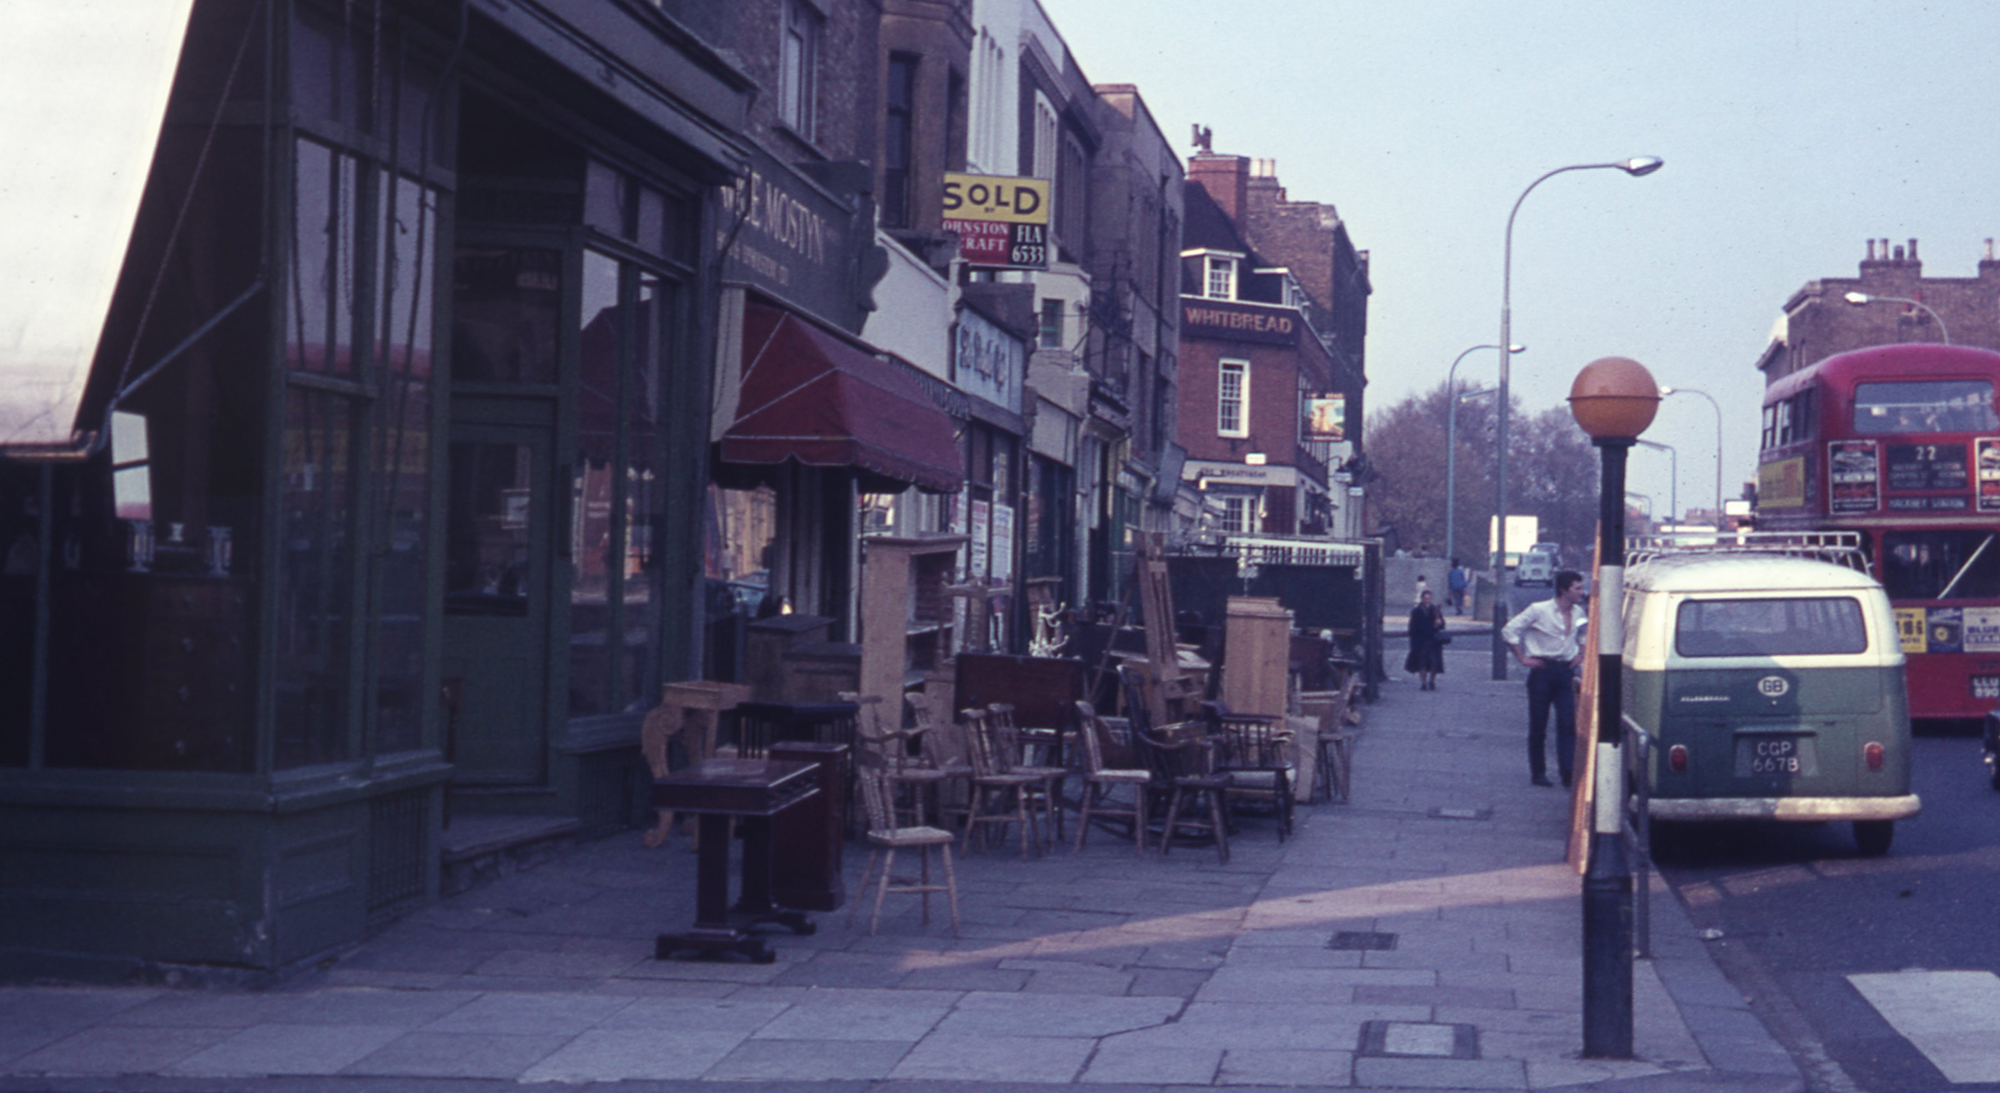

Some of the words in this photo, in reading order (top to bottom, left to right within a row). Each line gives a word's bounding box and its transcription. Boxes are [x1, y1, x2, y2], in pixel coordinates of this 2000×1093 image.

[942, 183, 1040, 215] SOLD
[942, 221, 1009, 236] OHNSTON
[1017, 225, 1042, 243] FLA
[1012, 246, 1044, 263] 6533
[1185, 307, 1292, 334] WHITBREAD
[1916, 446, 1936, 461] 22
[1763, 680, 1783, 693] GB
[1973, 677, 1999, 687] LLU
[1757, 742, 1791, 755] CGP
[1753, 757, 1798, 772] 667B
